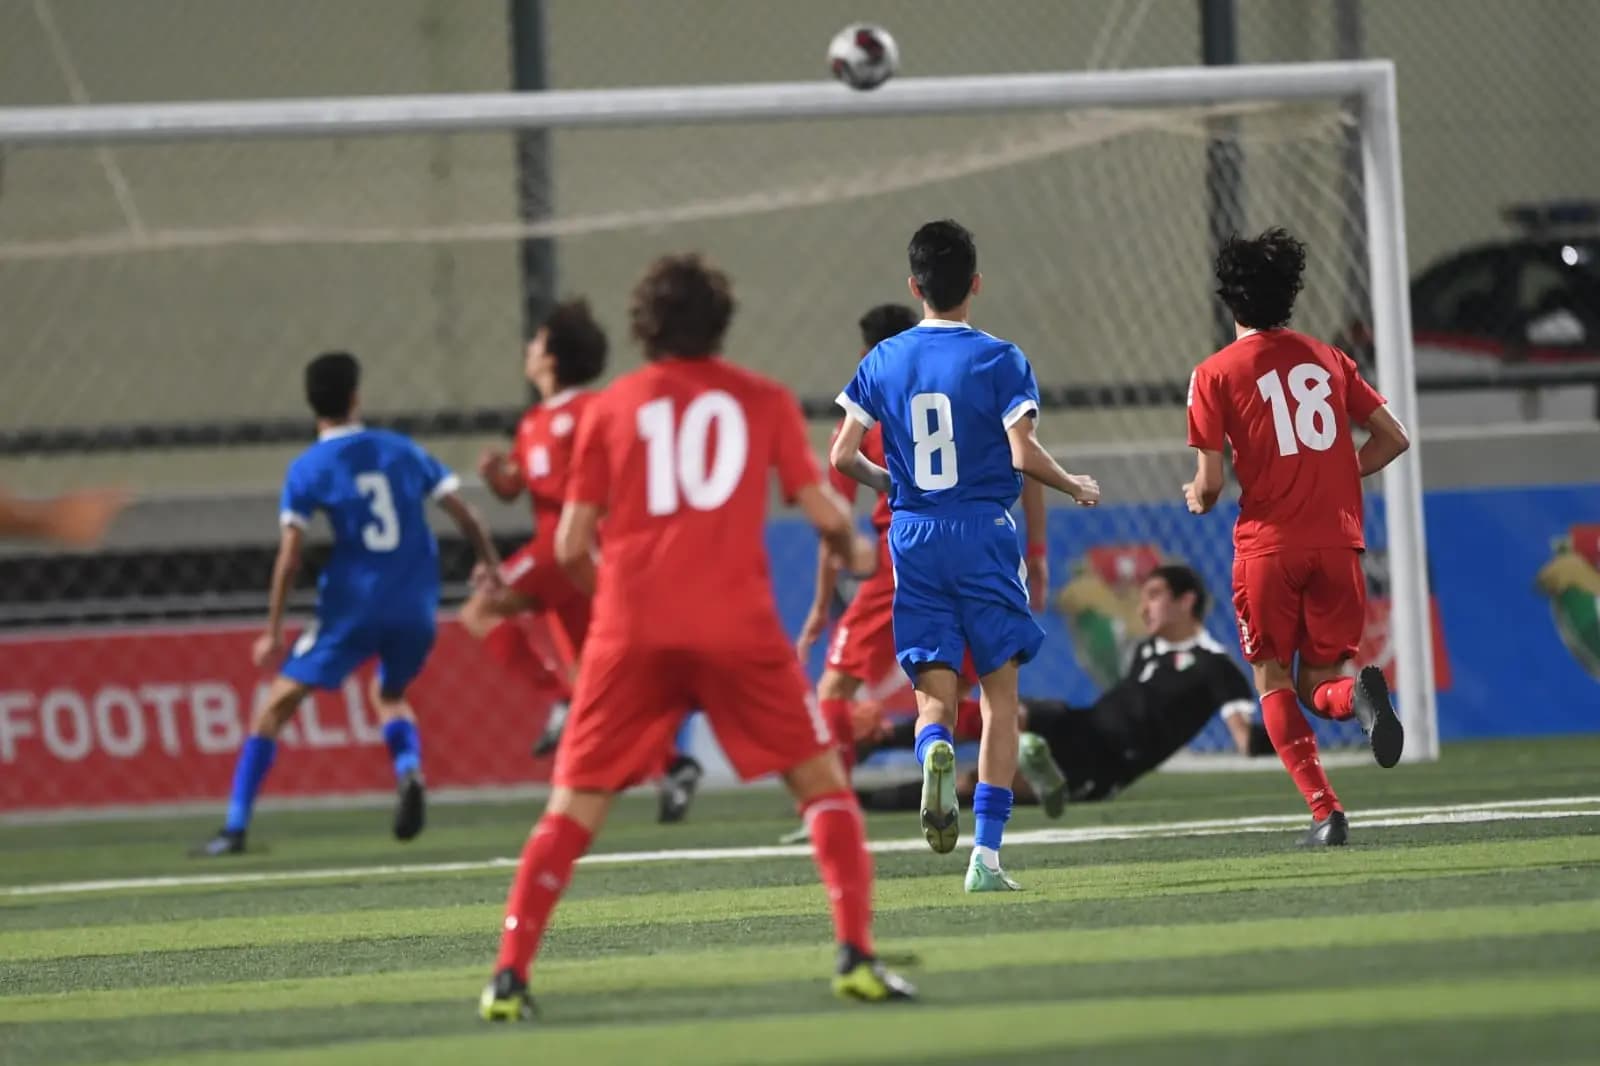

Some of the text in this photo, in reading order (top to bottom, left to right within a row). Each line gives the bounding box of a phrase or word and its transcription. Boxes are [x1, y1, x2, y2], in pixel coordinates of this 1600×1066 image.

[636, 390, 749, 516] 10
[910, 392, 959, 491] 8
[1256, 363, 1337, 456] 18
[355, 472, 400, 552] 3
